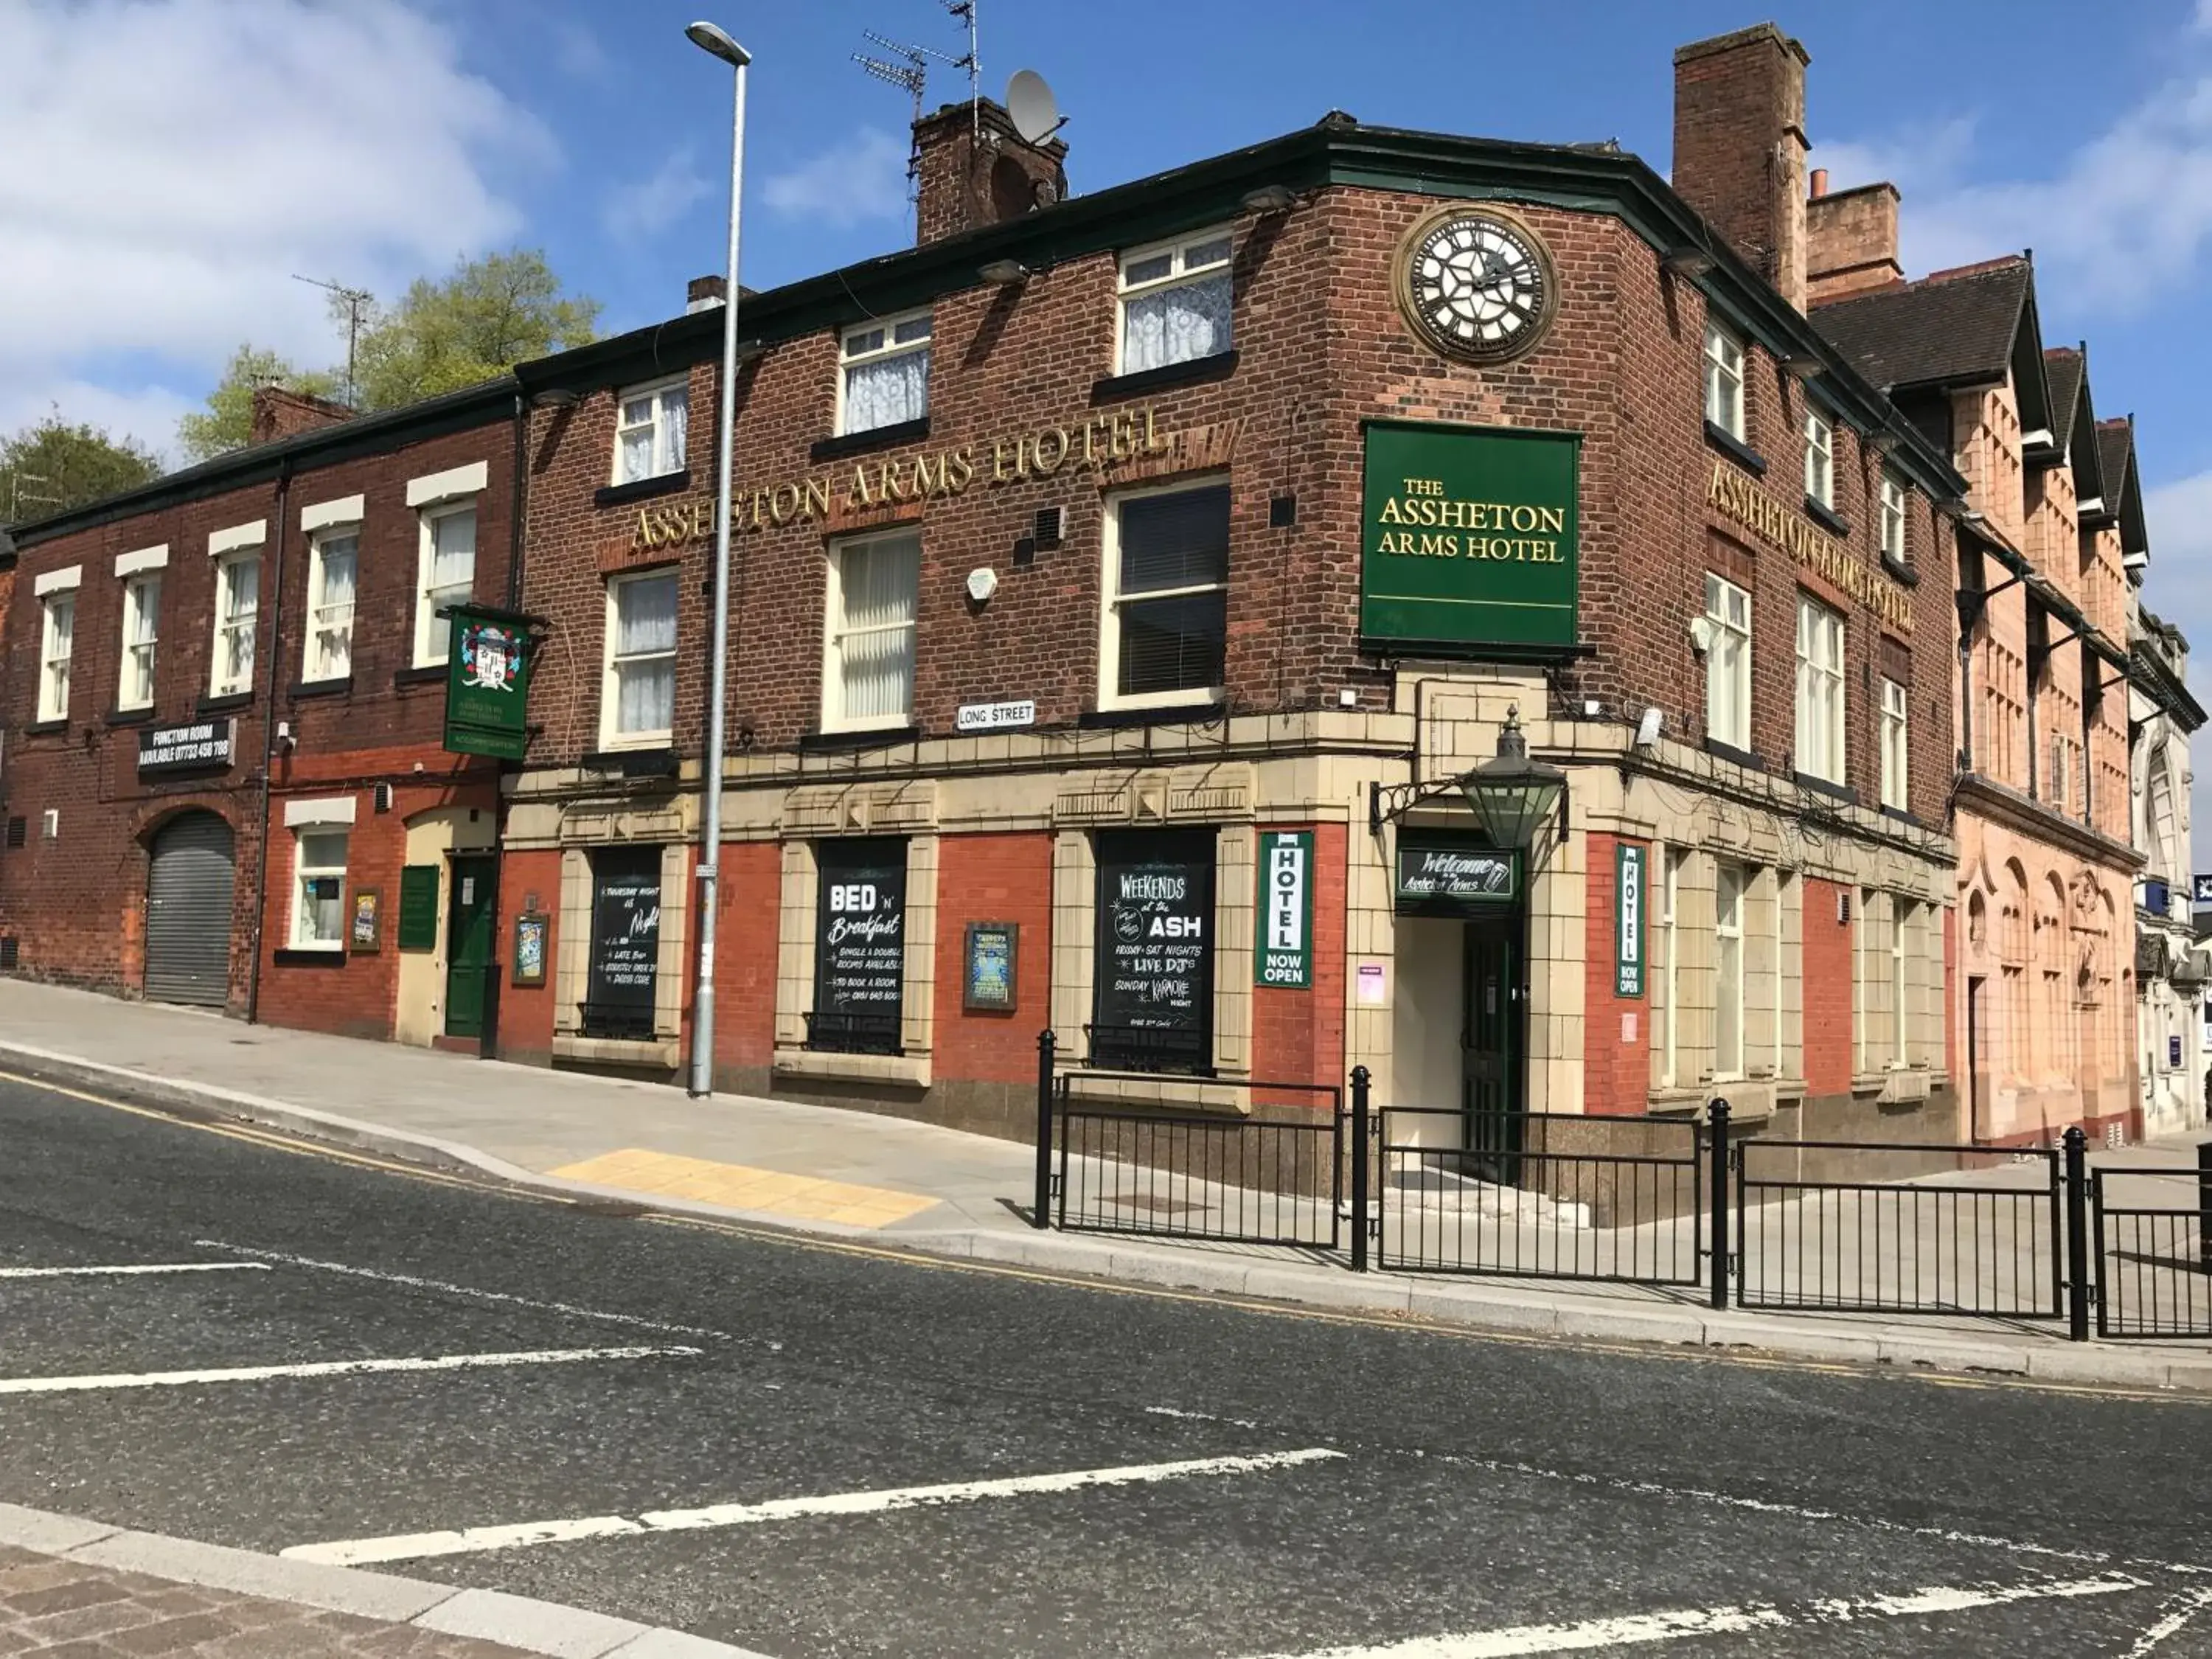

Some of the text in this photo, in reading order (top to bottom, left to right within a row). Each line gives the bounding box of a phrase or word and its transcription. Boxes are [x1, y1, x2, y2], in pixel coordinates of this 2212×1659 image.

[846, 446, 973, 508] ARMS
[992, 407, 1172, 481] HOTEL
[1403, 479, 1444, 496] THE
[1378, 497, 1565, 533] ASSHETON
[1377, 532, 1565, 563] ARMS HOTEL
[960, 706, 1032, 724] LONG STREET
[153, 724, 213, 747] FUNCTION ROOM
[139, 746, 175, 765] AVAILABLE
[1421, 852, 1495, 874] Welcome
[830, 885, 876, 911] BED
[1277, 851, 1295, 947] HOTEL
[1626, 865, 1635, 958] HOTEL
[828, 914, 900, 945] Breakfast
[1150, 917, 1201, 937] ASH
[1146, 945, 1164, 956] SAT
[1165, 945, 1203, 957] NIGHTS
[837, 959, 863, 970] ROOMS
[1134, 958, 1163, 973] LIVE
[1267, 954, 1301, 968] NOW
[1265, 968, 1303, 983] OPEN
[1621, 966, 1637, 979] NOW
[848, 977, 866, 987] BOOK
[874, 977, 897, 988] ROOM
[1114, 979, 1149, 991] SUNDAY
[1620, 980, 1638, 992] OPEN
